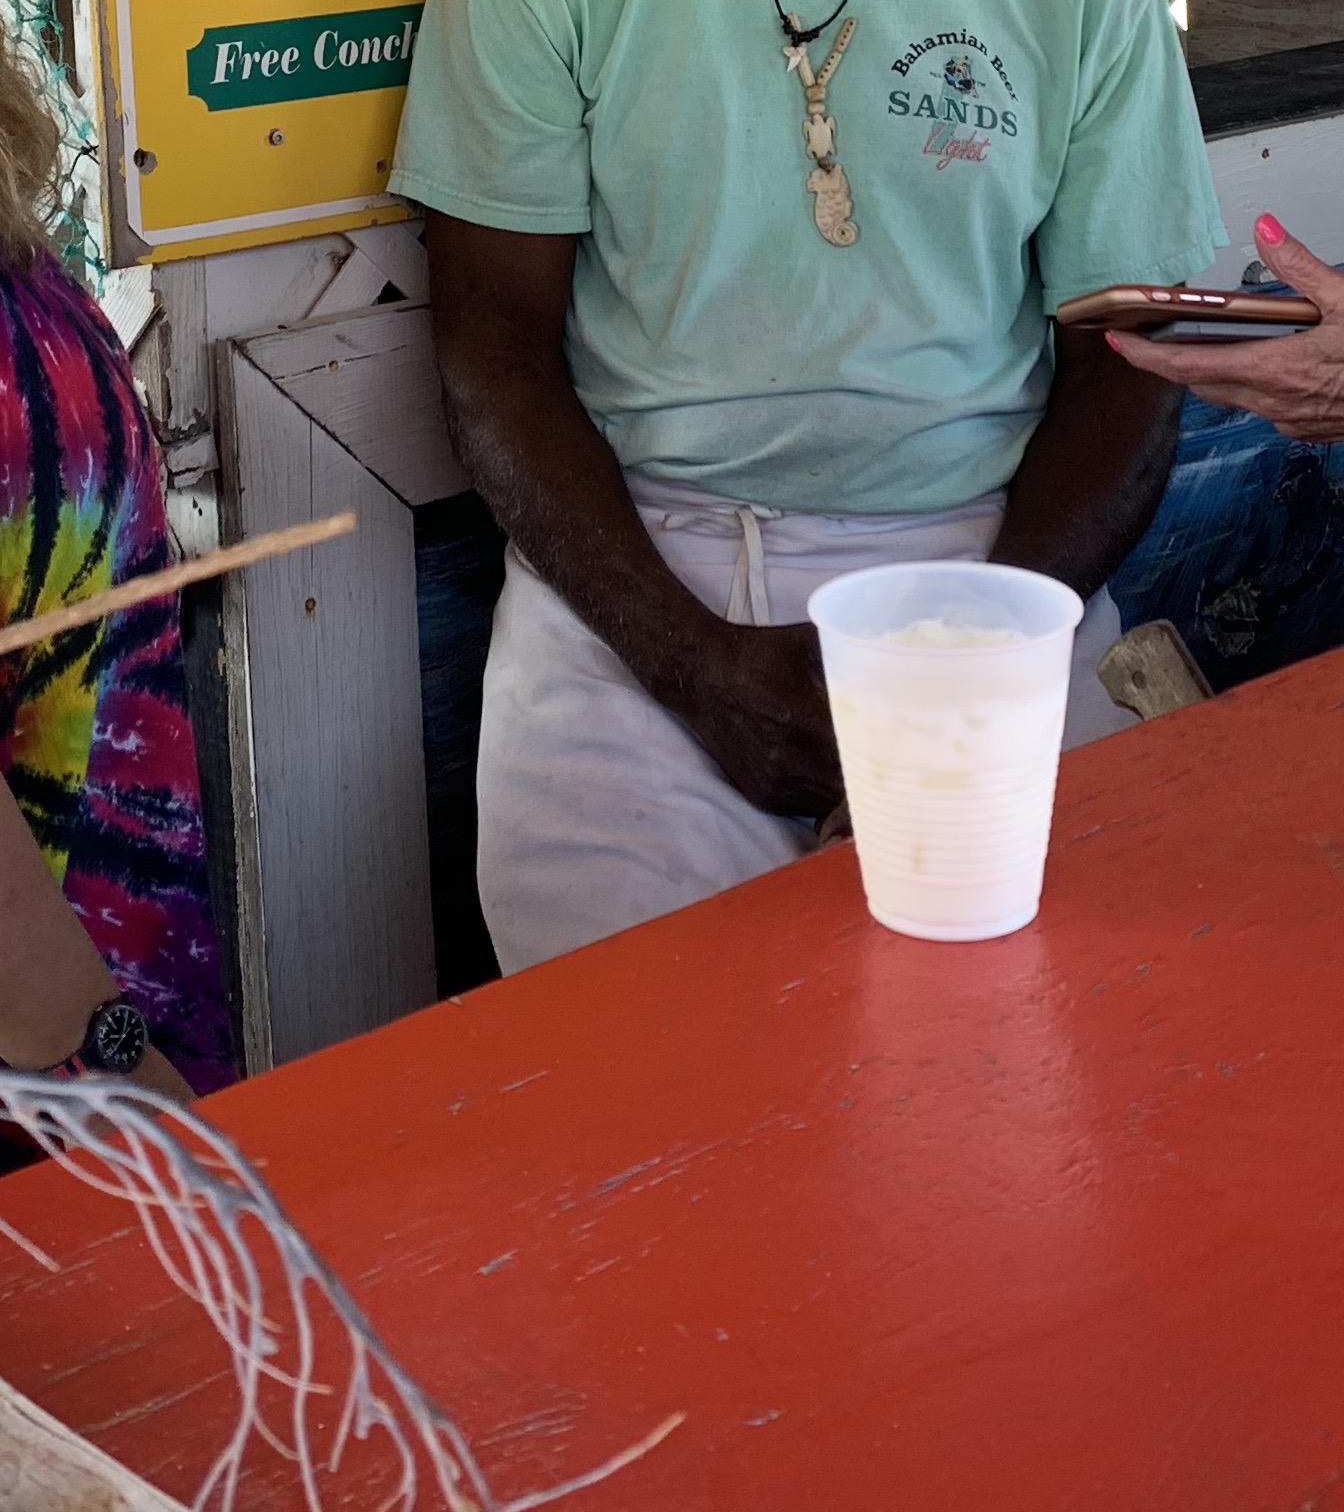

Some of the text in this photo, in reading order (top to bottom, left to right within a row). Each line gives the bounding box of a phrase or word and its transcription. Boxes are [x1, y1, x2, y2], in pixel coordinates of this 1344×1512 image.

[210, 41, 301, 85] Free
[891, 29, 1019, 102] Bahamian Beer
[887, 90, 1019, 137] SANDS
[923, 122, 992, 171] Light
